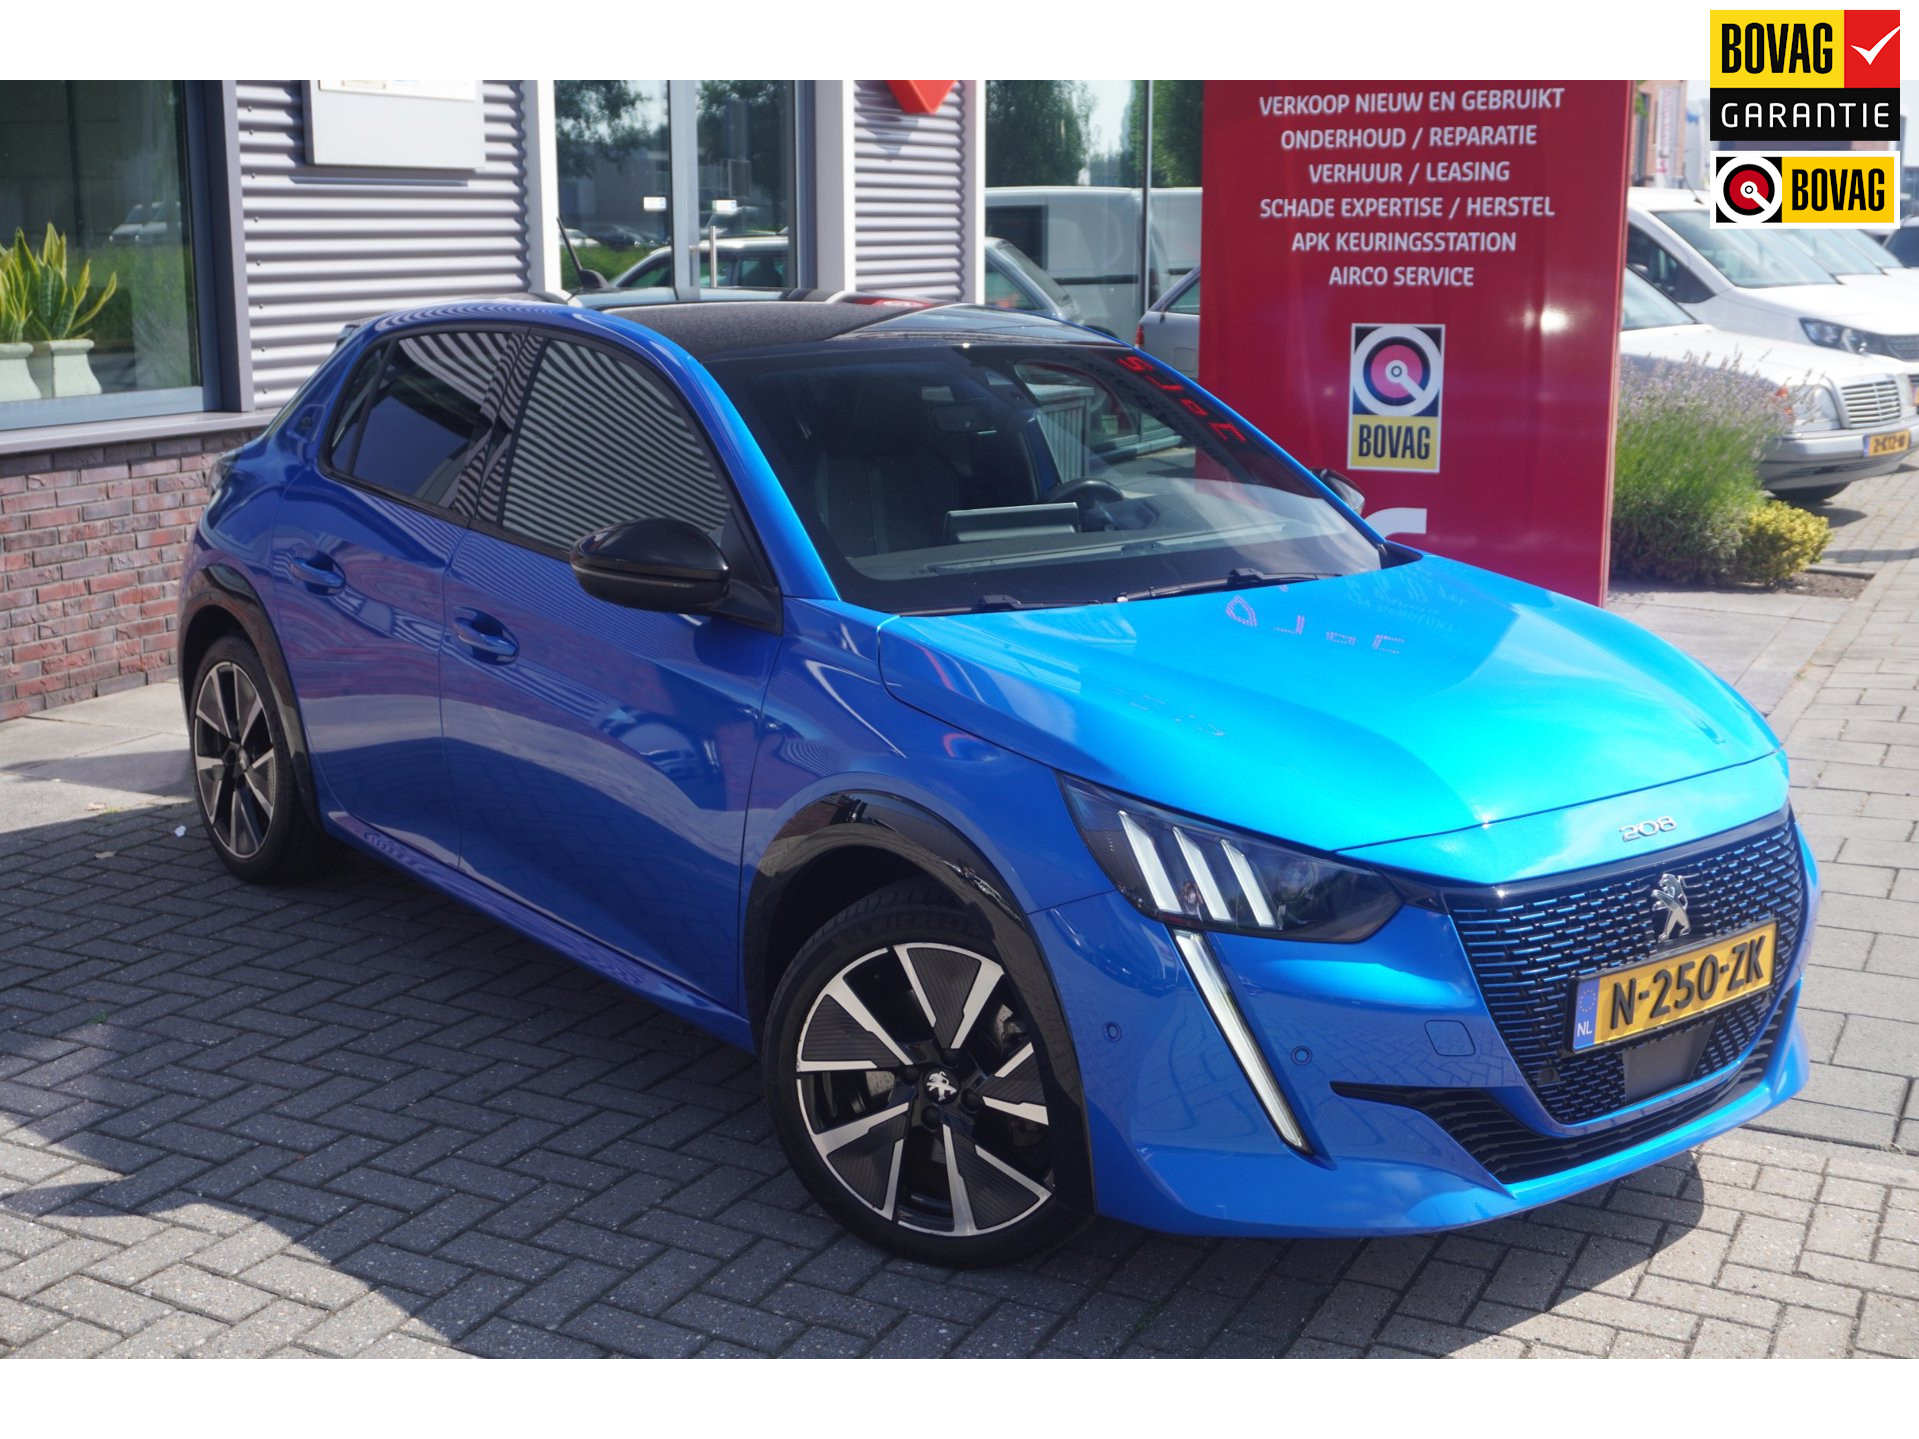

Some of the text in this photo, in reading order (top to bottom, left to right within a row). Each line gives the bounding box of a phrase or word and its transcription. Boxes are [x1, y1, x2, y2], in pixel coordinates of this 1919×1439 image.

[1260, 88, 1565, 116] VERKOOP NIEUW EN GEBRUIKT
[1281, 128, 1406, 150] ONDERHOUD
[1430, 125, 1537, 146] REPARATIE
[1309, 163, 1402, 183] VERHUUR
[1426, 161, 1510, 182] LEASING
[1260, 198, 1335, 218] SCHADE
[1341, 197, 1443, 217] EXPERTISE
[1467, 196, 1555, 217] HERSTEL
[1292, 232, 1516, 252] APK KEURINGSSTATION
[1329, 266, 1474, 286] AIRCO SERVICE
[1358, 424, 1430, 460] BOVAG
[1619, 816, 1677, 843] 208
[1610, 935, 1765, 1030] N-250-ZK
[1577, 1021, 1592, 1037] NL
